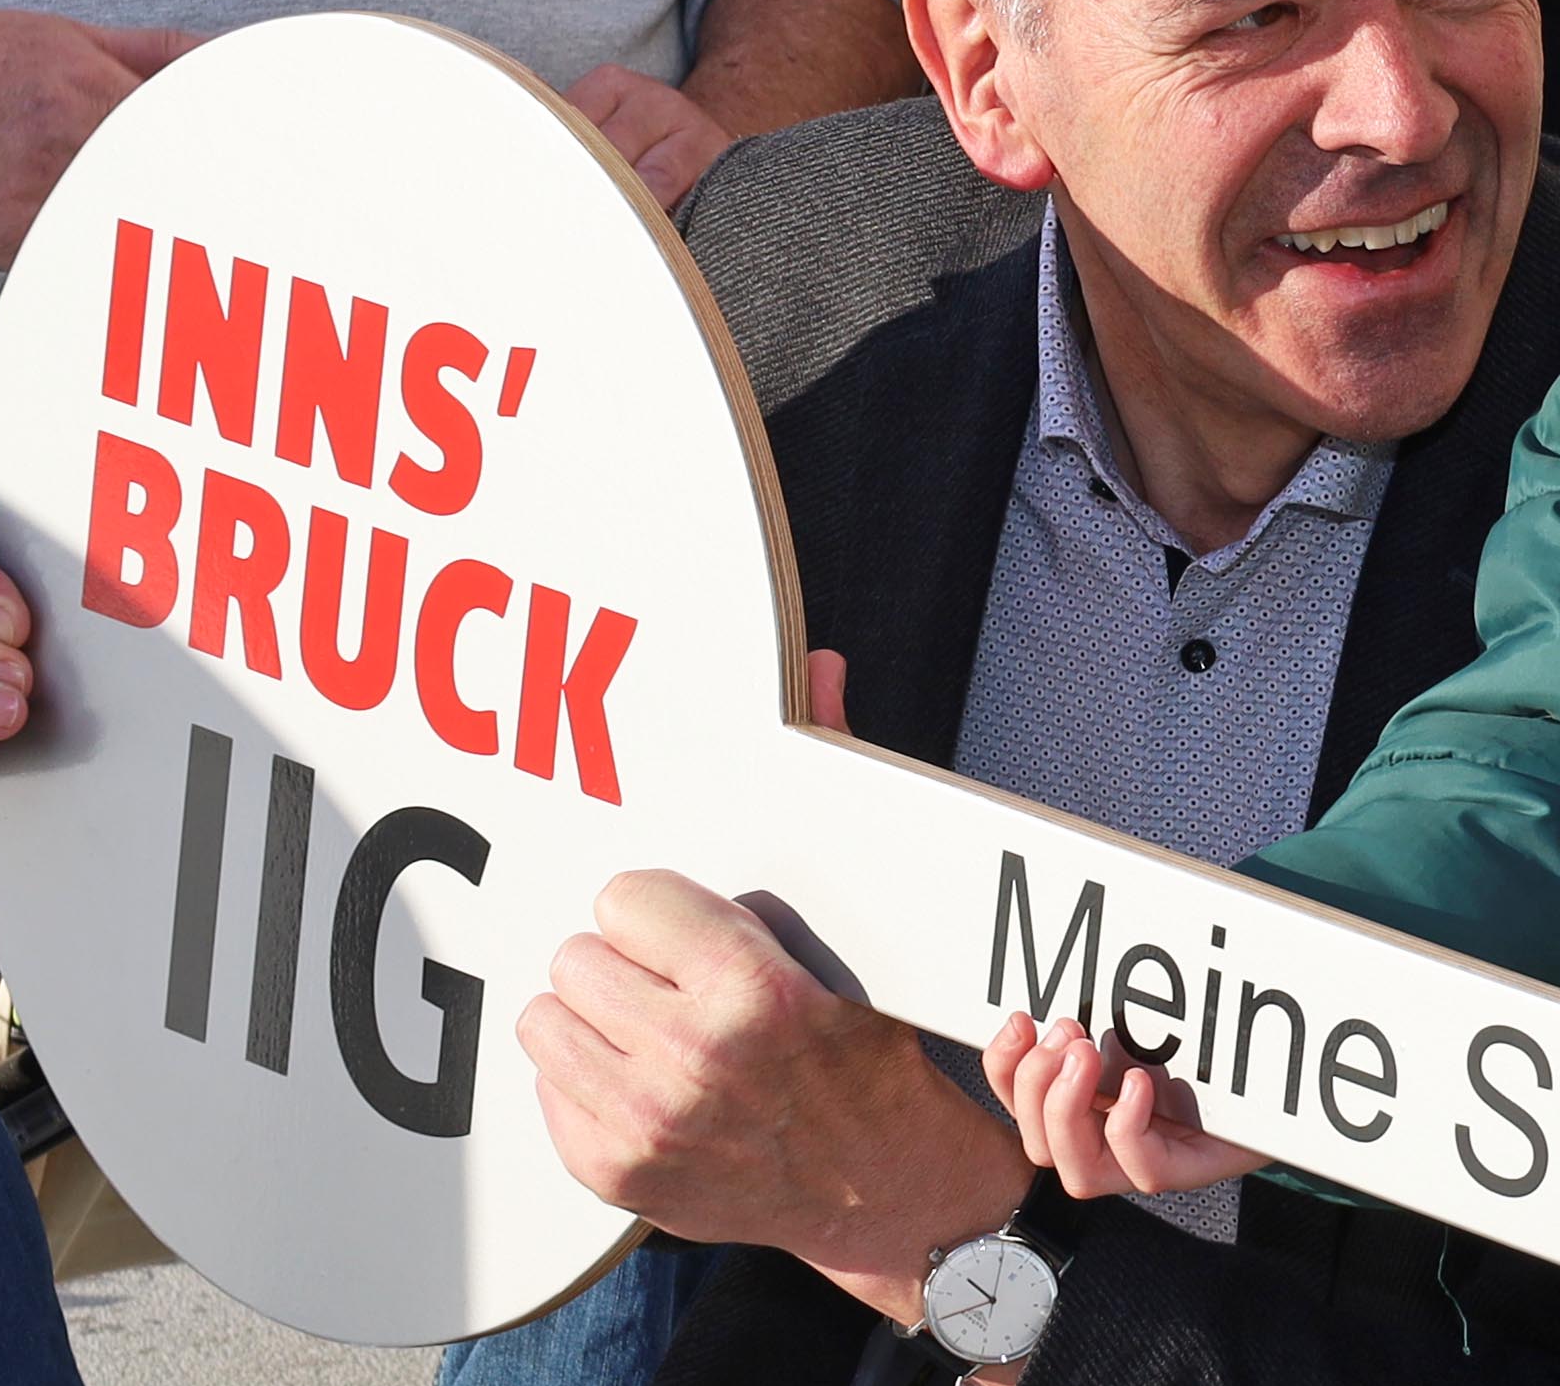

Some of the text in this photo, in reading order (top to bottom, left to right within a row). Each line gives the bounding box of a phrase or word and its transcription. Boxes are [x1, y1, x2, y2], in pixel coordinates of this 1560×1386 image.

[82, 430, 639, 807] BRUCK
[163, 722, 493, 1139] IIG
[986, 849, 1398, 1144] Meine
